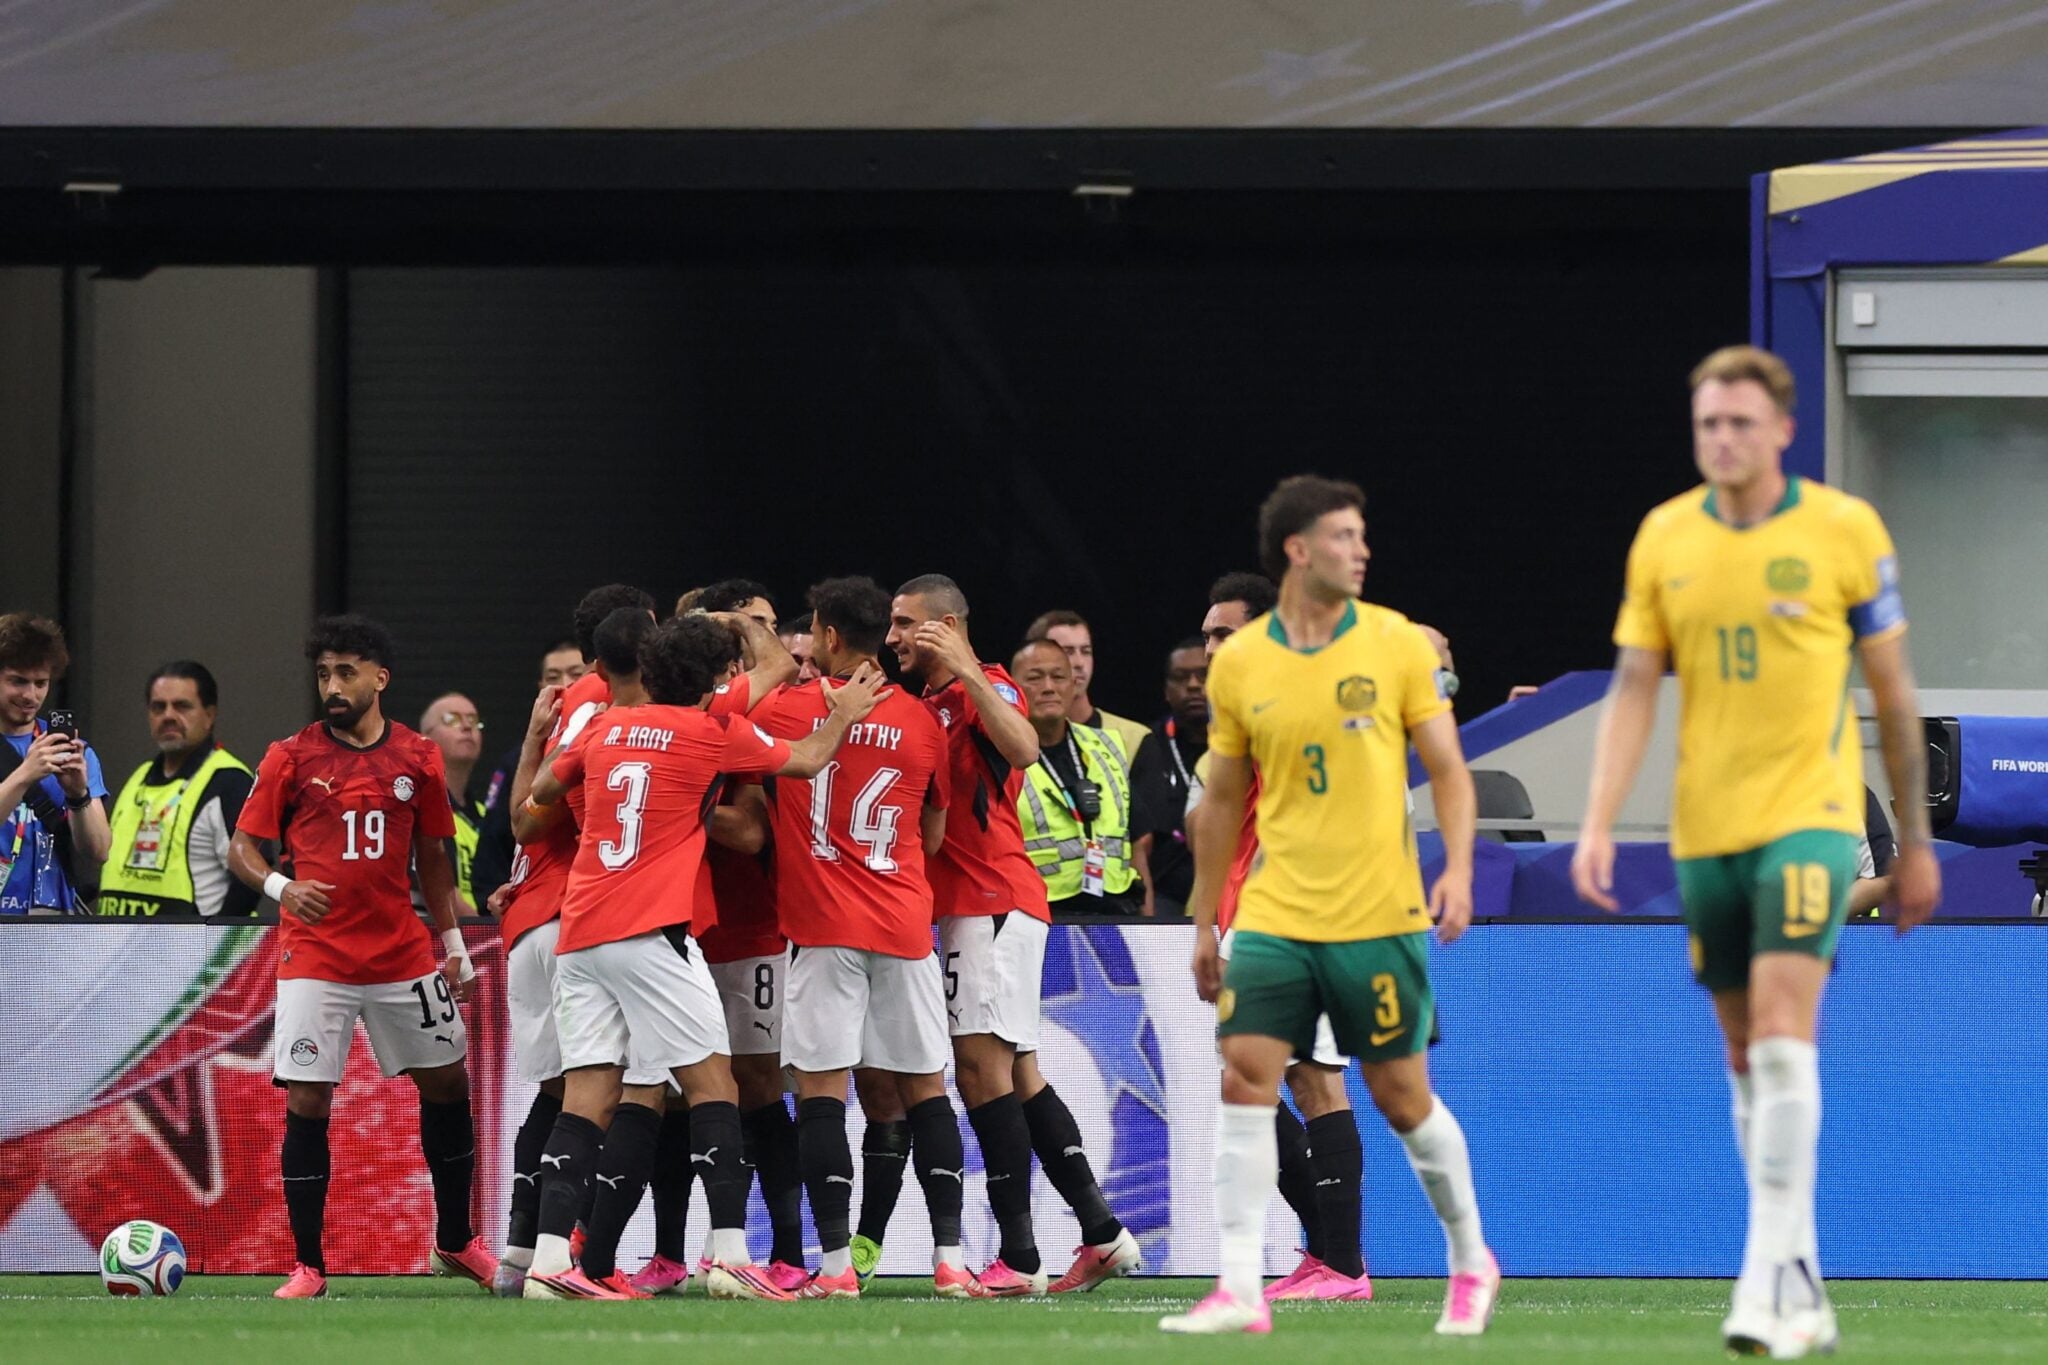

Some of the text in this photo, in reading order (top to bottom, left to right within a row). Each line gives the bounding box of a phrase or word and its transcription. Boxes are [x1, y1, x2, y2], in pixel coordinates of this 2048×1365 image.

[1716, 626, 1759, 682] 19
[626, 726, 674, 751] HANY
[849, 723, 902, 750] ATHY
[1303, 744, 1328, 795] 3
[1992, 759, 2017, 771] FIFA
[341, 809, 386, 861] 19
[599, 761, 652, 871] 3
[808, 761, 903, 873] 14
[1783, 862, 1831, 926] 19
[411, 975, 456, 1029] 19
[755, 964, 774, 1010] 8
[1370, 973, 1401, 1029] 3
